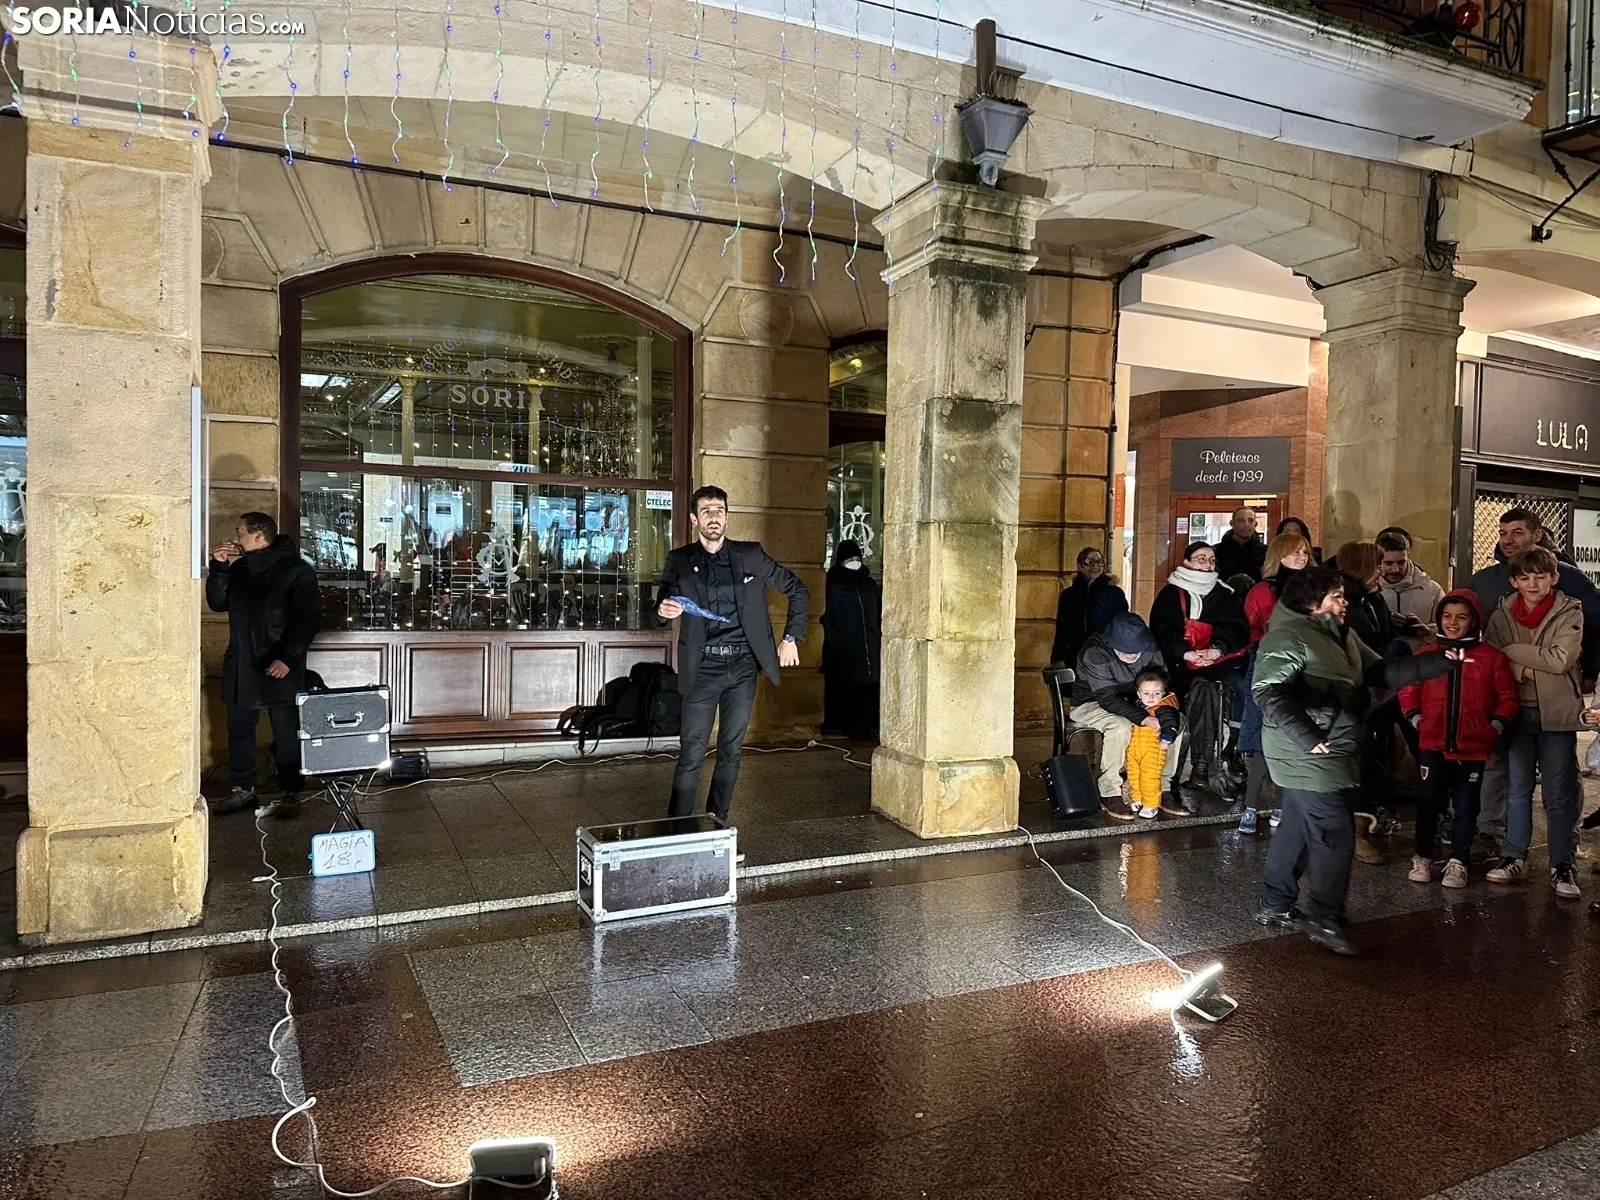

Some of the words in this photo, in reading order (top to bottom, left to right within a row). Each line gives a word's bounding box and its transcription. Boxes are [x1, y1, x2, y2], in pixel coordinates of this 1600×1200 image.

[450, 384, 546, 411] SORIA
[1536, 419, 1588, 451] LULA
[1200, 450, 1260, 464] Peleteros
[1195, 470, 1229, 483] desde
[1233, 470, 1264, 483] 1939
[646, 498, 672, 506] CTELEC
